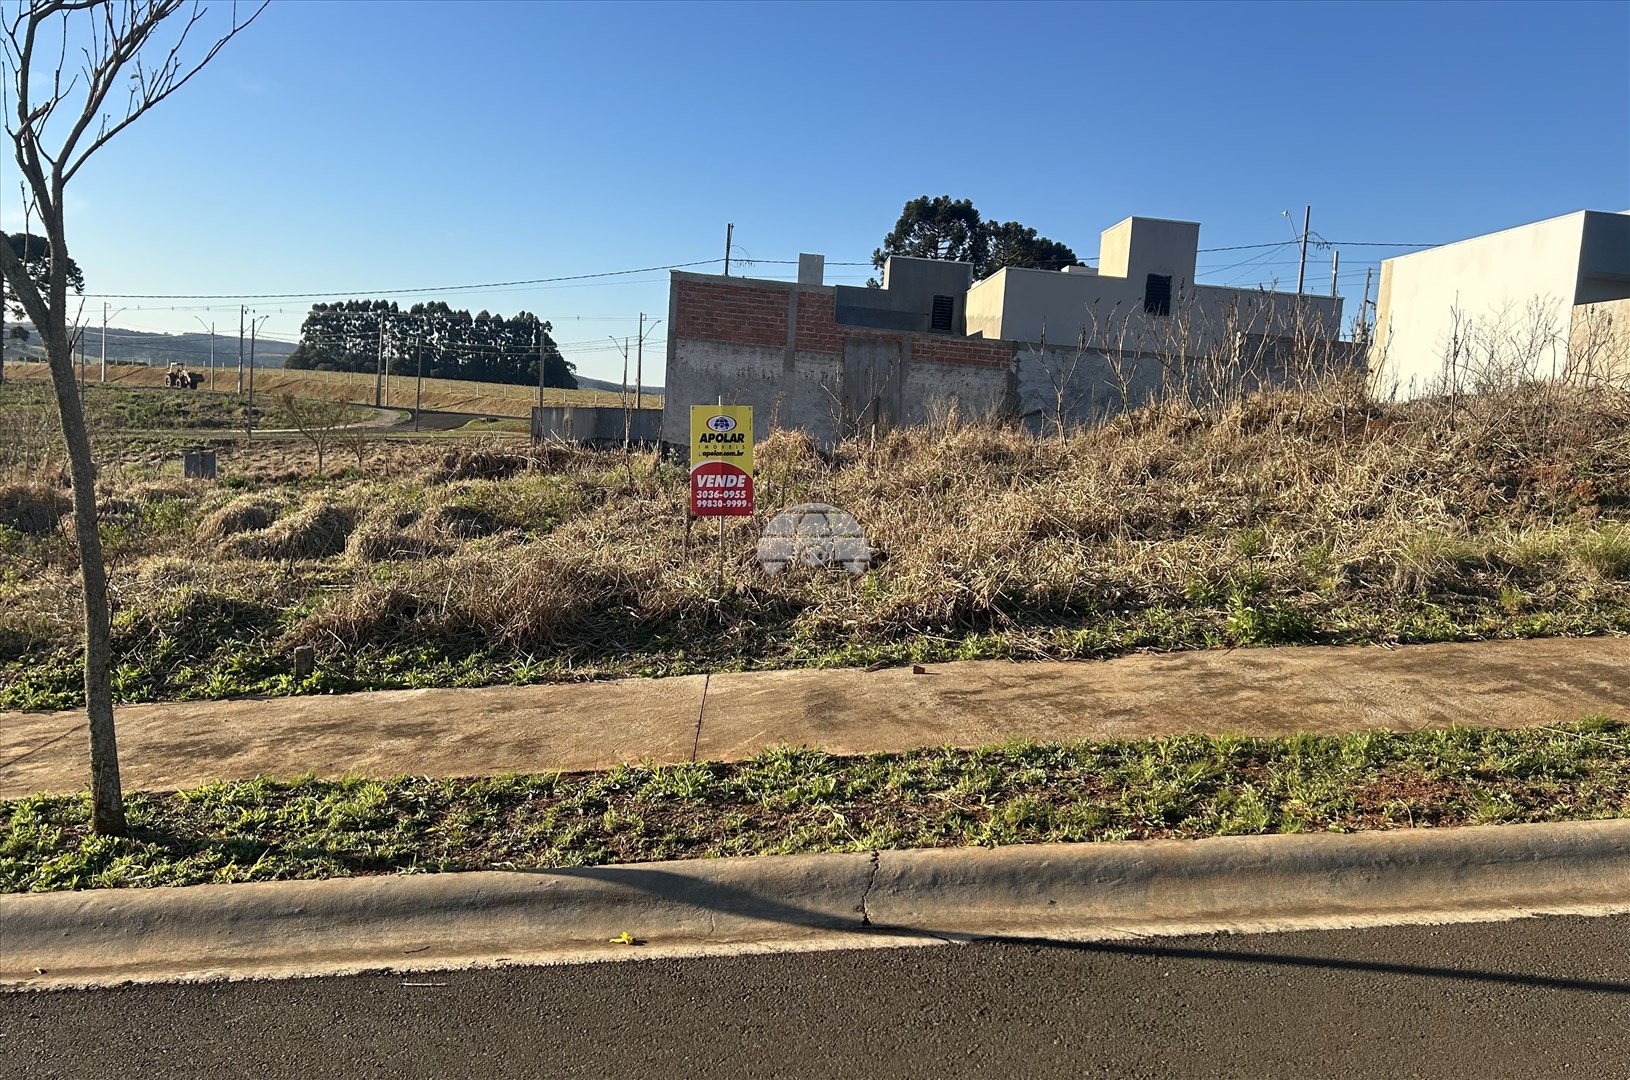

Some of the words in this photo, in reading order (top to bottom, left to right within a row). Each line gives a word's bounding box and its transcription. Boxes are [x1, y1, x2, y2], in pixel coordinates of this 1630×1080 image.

[699, 433, 745, 443] APOLAR
[696, 474, 746, 487] VENDE
[696, 490, 746, 498] 3036-0955
[696, 499, 747, 507] 99830-9999
